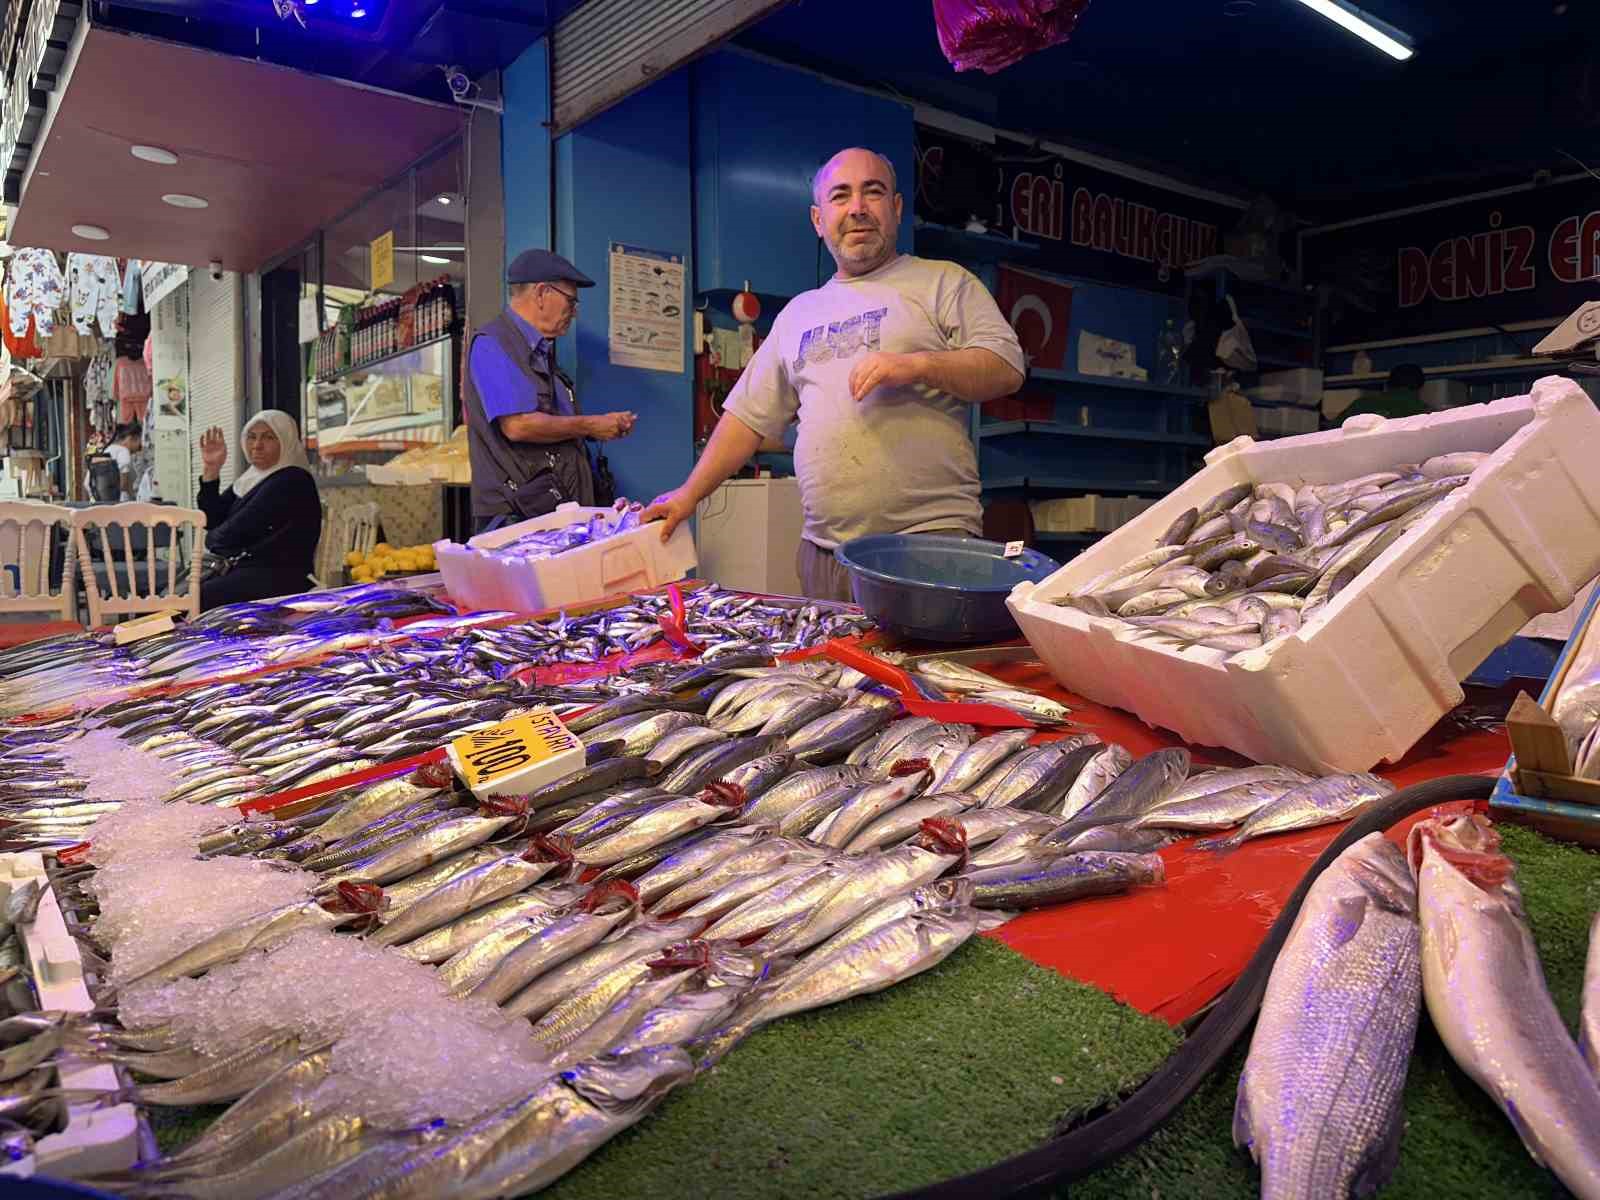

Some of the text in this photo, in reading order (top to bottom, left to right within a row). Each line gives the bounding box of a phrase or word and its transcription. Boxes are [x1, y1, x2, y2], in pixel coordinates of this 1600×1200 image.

[1399, 210, 1536, 308] DENİZ
[792, 307, 887, 373] JUST
[466, 739, 532, 774] 100
